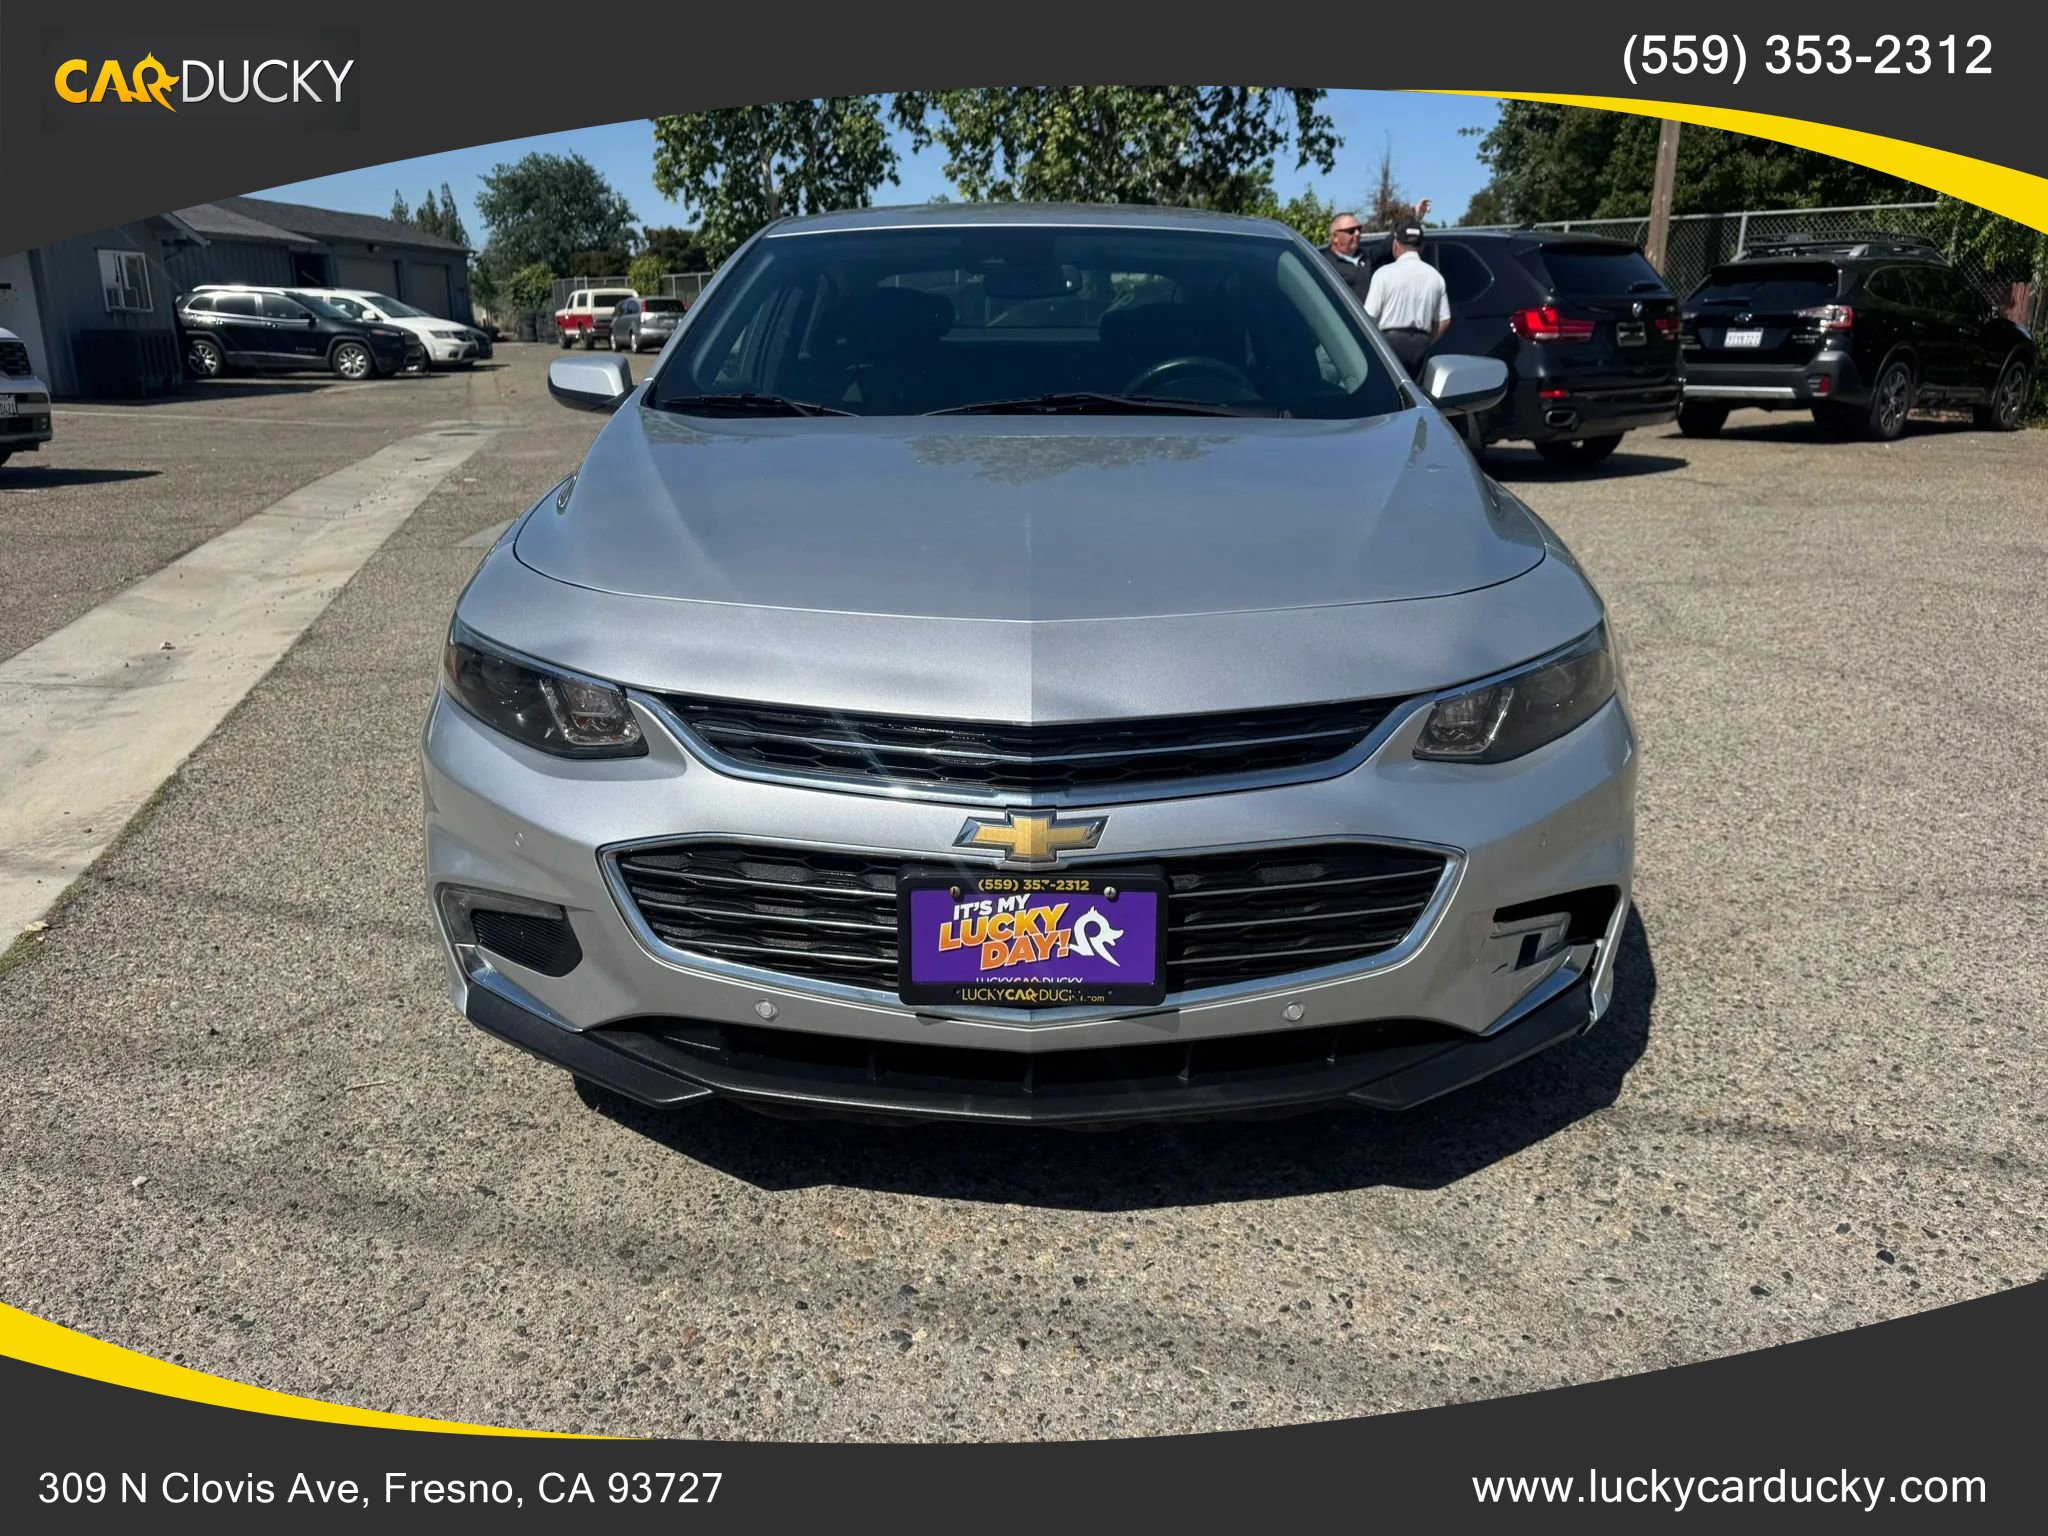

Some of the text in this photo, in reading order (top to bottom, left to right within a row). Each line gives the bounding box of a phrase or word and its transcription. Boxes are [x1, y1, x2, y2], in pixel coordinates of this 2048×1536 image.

[978, 879, 1019, 891] (559)
[997, 893, 1031, 914] MY
[939, 903, 1069, 951] LUCKY
[980, 928, 1071, 970] DAY!
